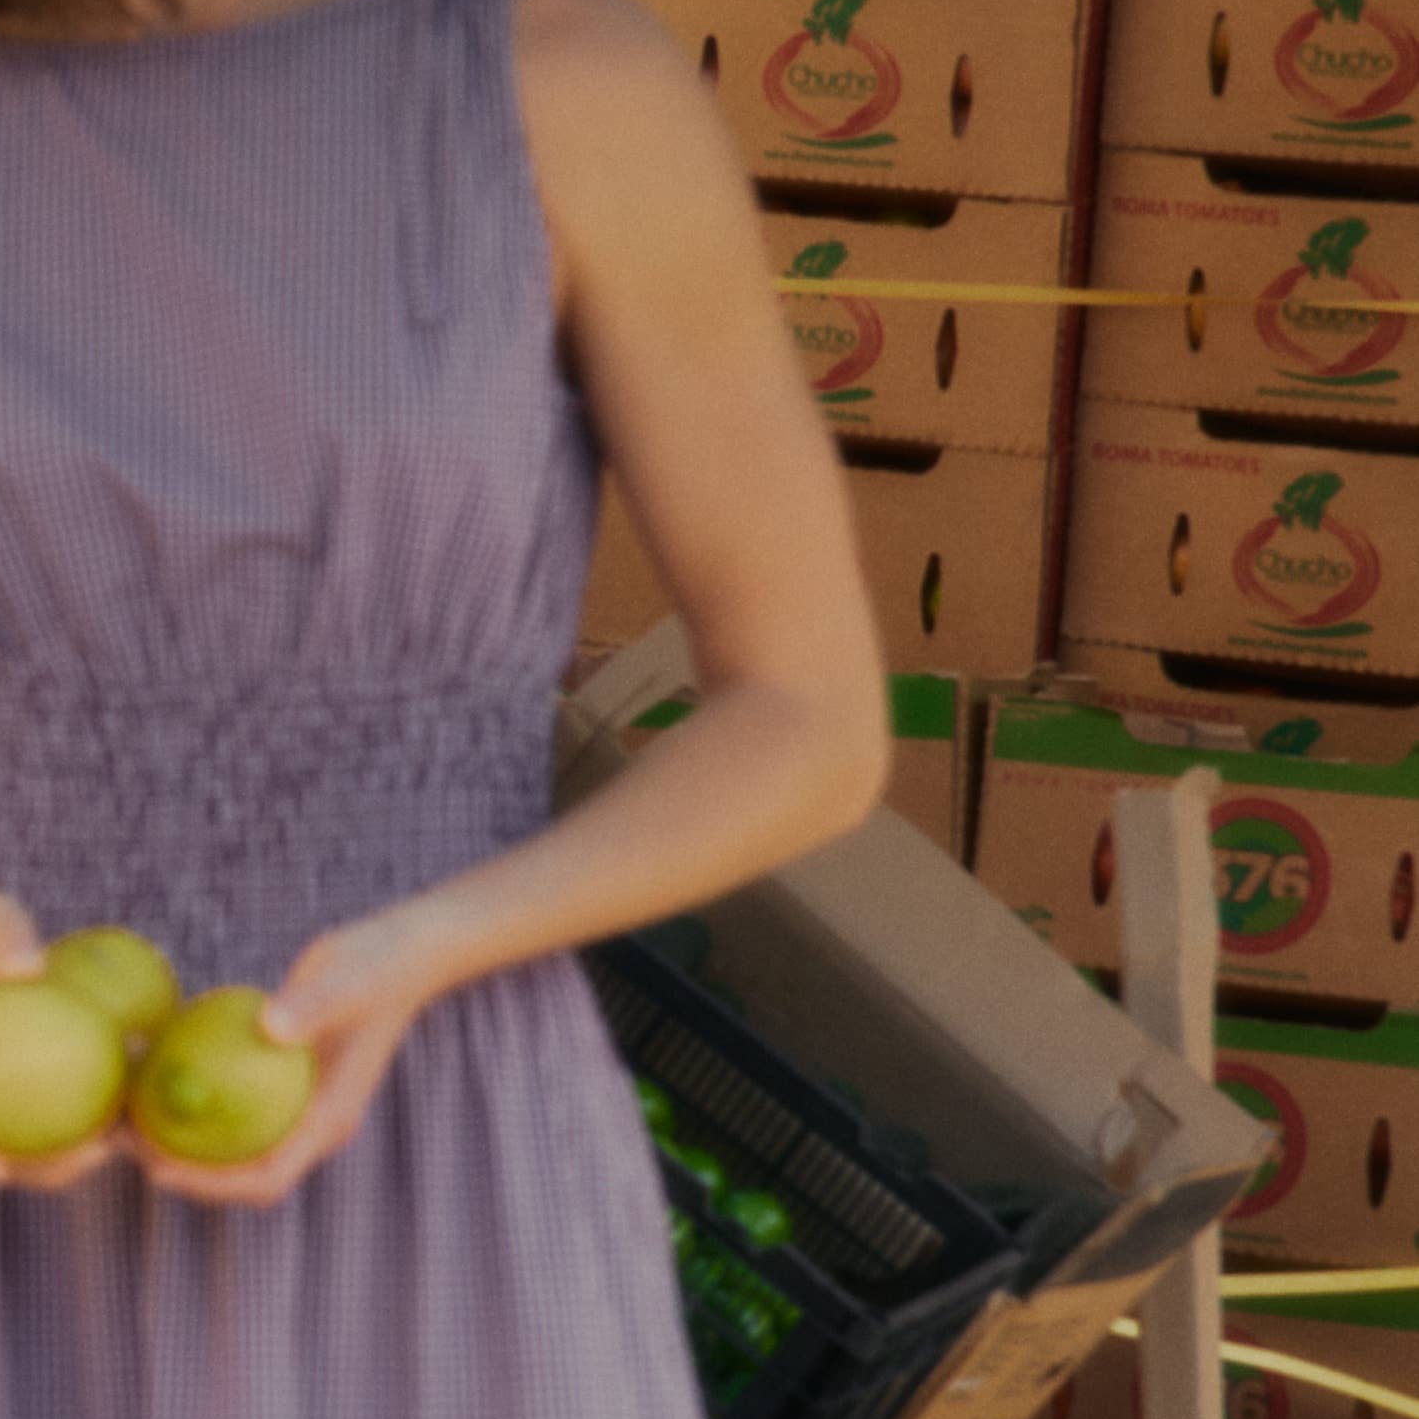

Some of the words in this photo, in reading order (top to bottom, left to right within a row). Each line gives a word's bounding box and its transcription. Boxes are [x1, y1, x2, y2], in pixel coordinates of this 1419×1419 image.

[1298, 43, 1393, 71] Chucho
[788, 63, 879, 90] Chucho
[1092, 442, 1151, 463] ROMA
[1255, 550, 1352, 579] Chucho
